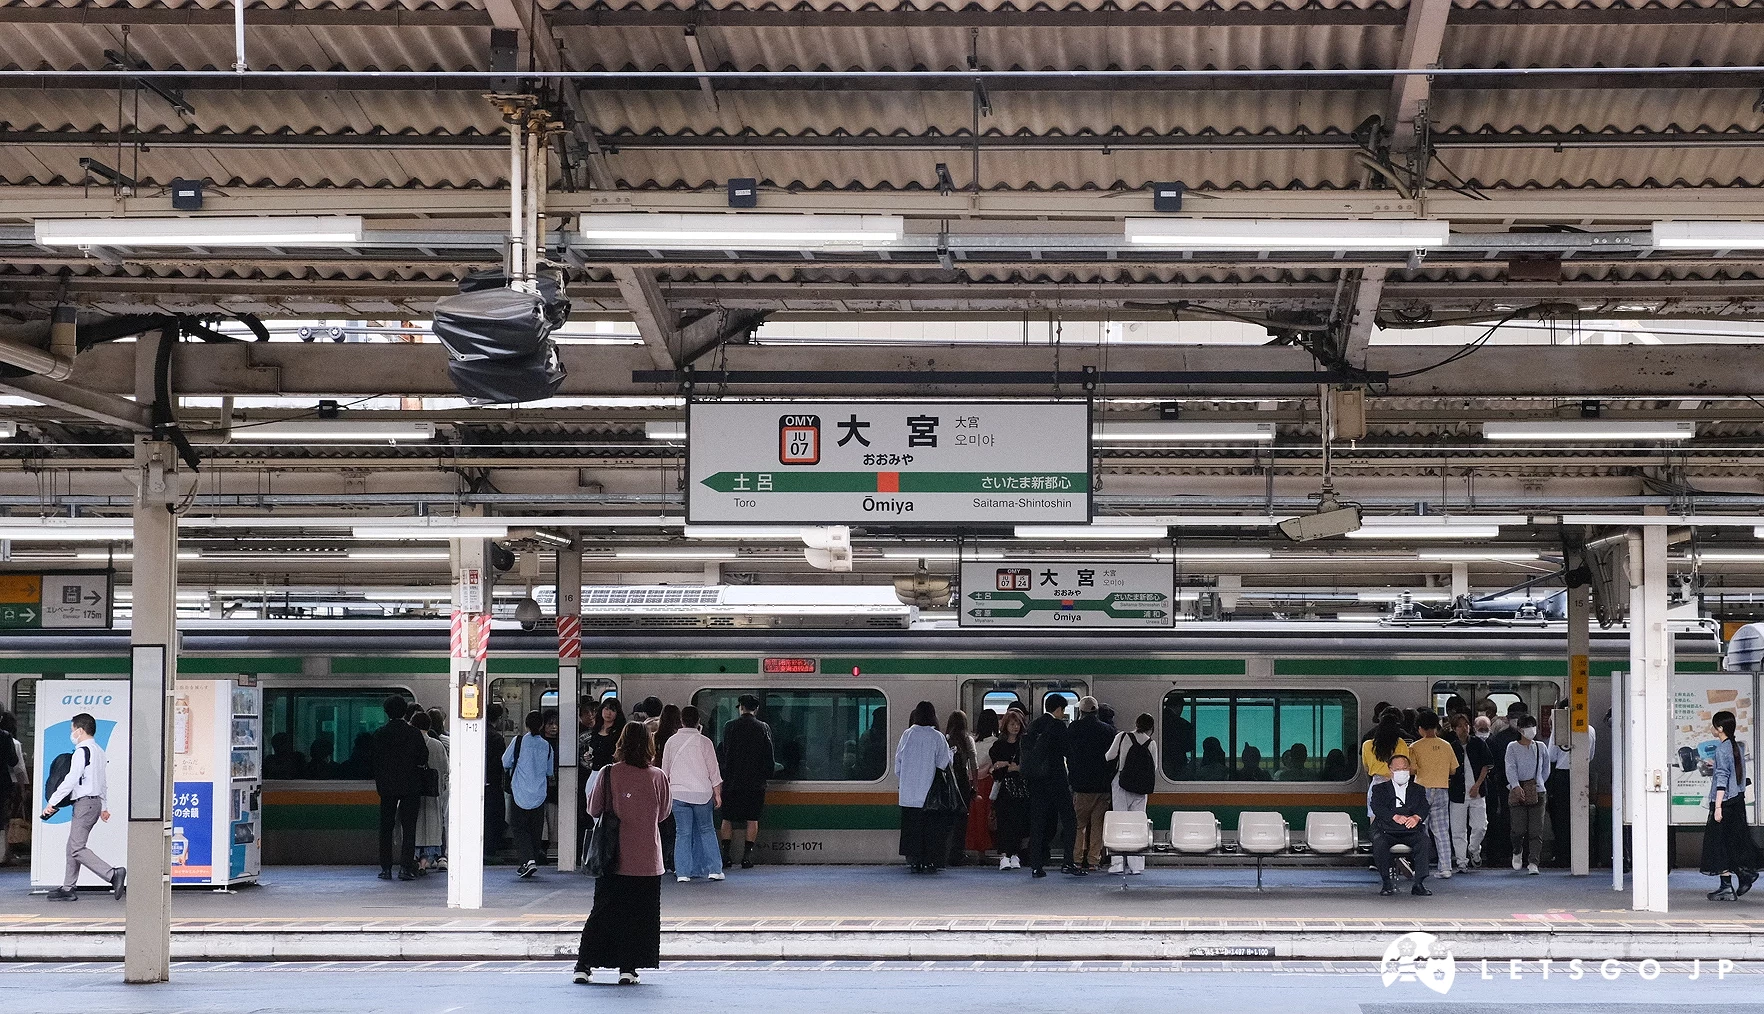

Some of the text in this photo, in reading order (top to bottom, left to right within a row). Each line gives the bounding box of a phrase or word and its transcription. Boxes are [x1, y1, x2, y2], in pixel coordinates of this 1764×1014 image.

[785, 416, 814, 426] OMY
[955, 416, 979, 428] 大宮
[837, 414, 939, 447] 大宮
[793, 432, 806, 442] JU
[955, 434, 995, 447] 오미야
[791, 443, 809, 455] 07
[863, 453, 914, 466] おおみや
[733, 473, 773, 491] 土呂
[981, 476, 1071, 489] さいたま新都心
[734, 498, 756, 508] Toro
[862, 495, 914, 514] Ōmiya
[973, 498, 1072, 508] Saitama-Shintoshin
[1040, 568, 1095, 587] 大宮
[1053, 589, 1082, 597] おおみや
[83, 610, 102, 619] 175m
[1053, 612, 1082, 622] Ōmiya
[62, 695, 112, 705] acure
[465, 723, 478, 732] 7-12
